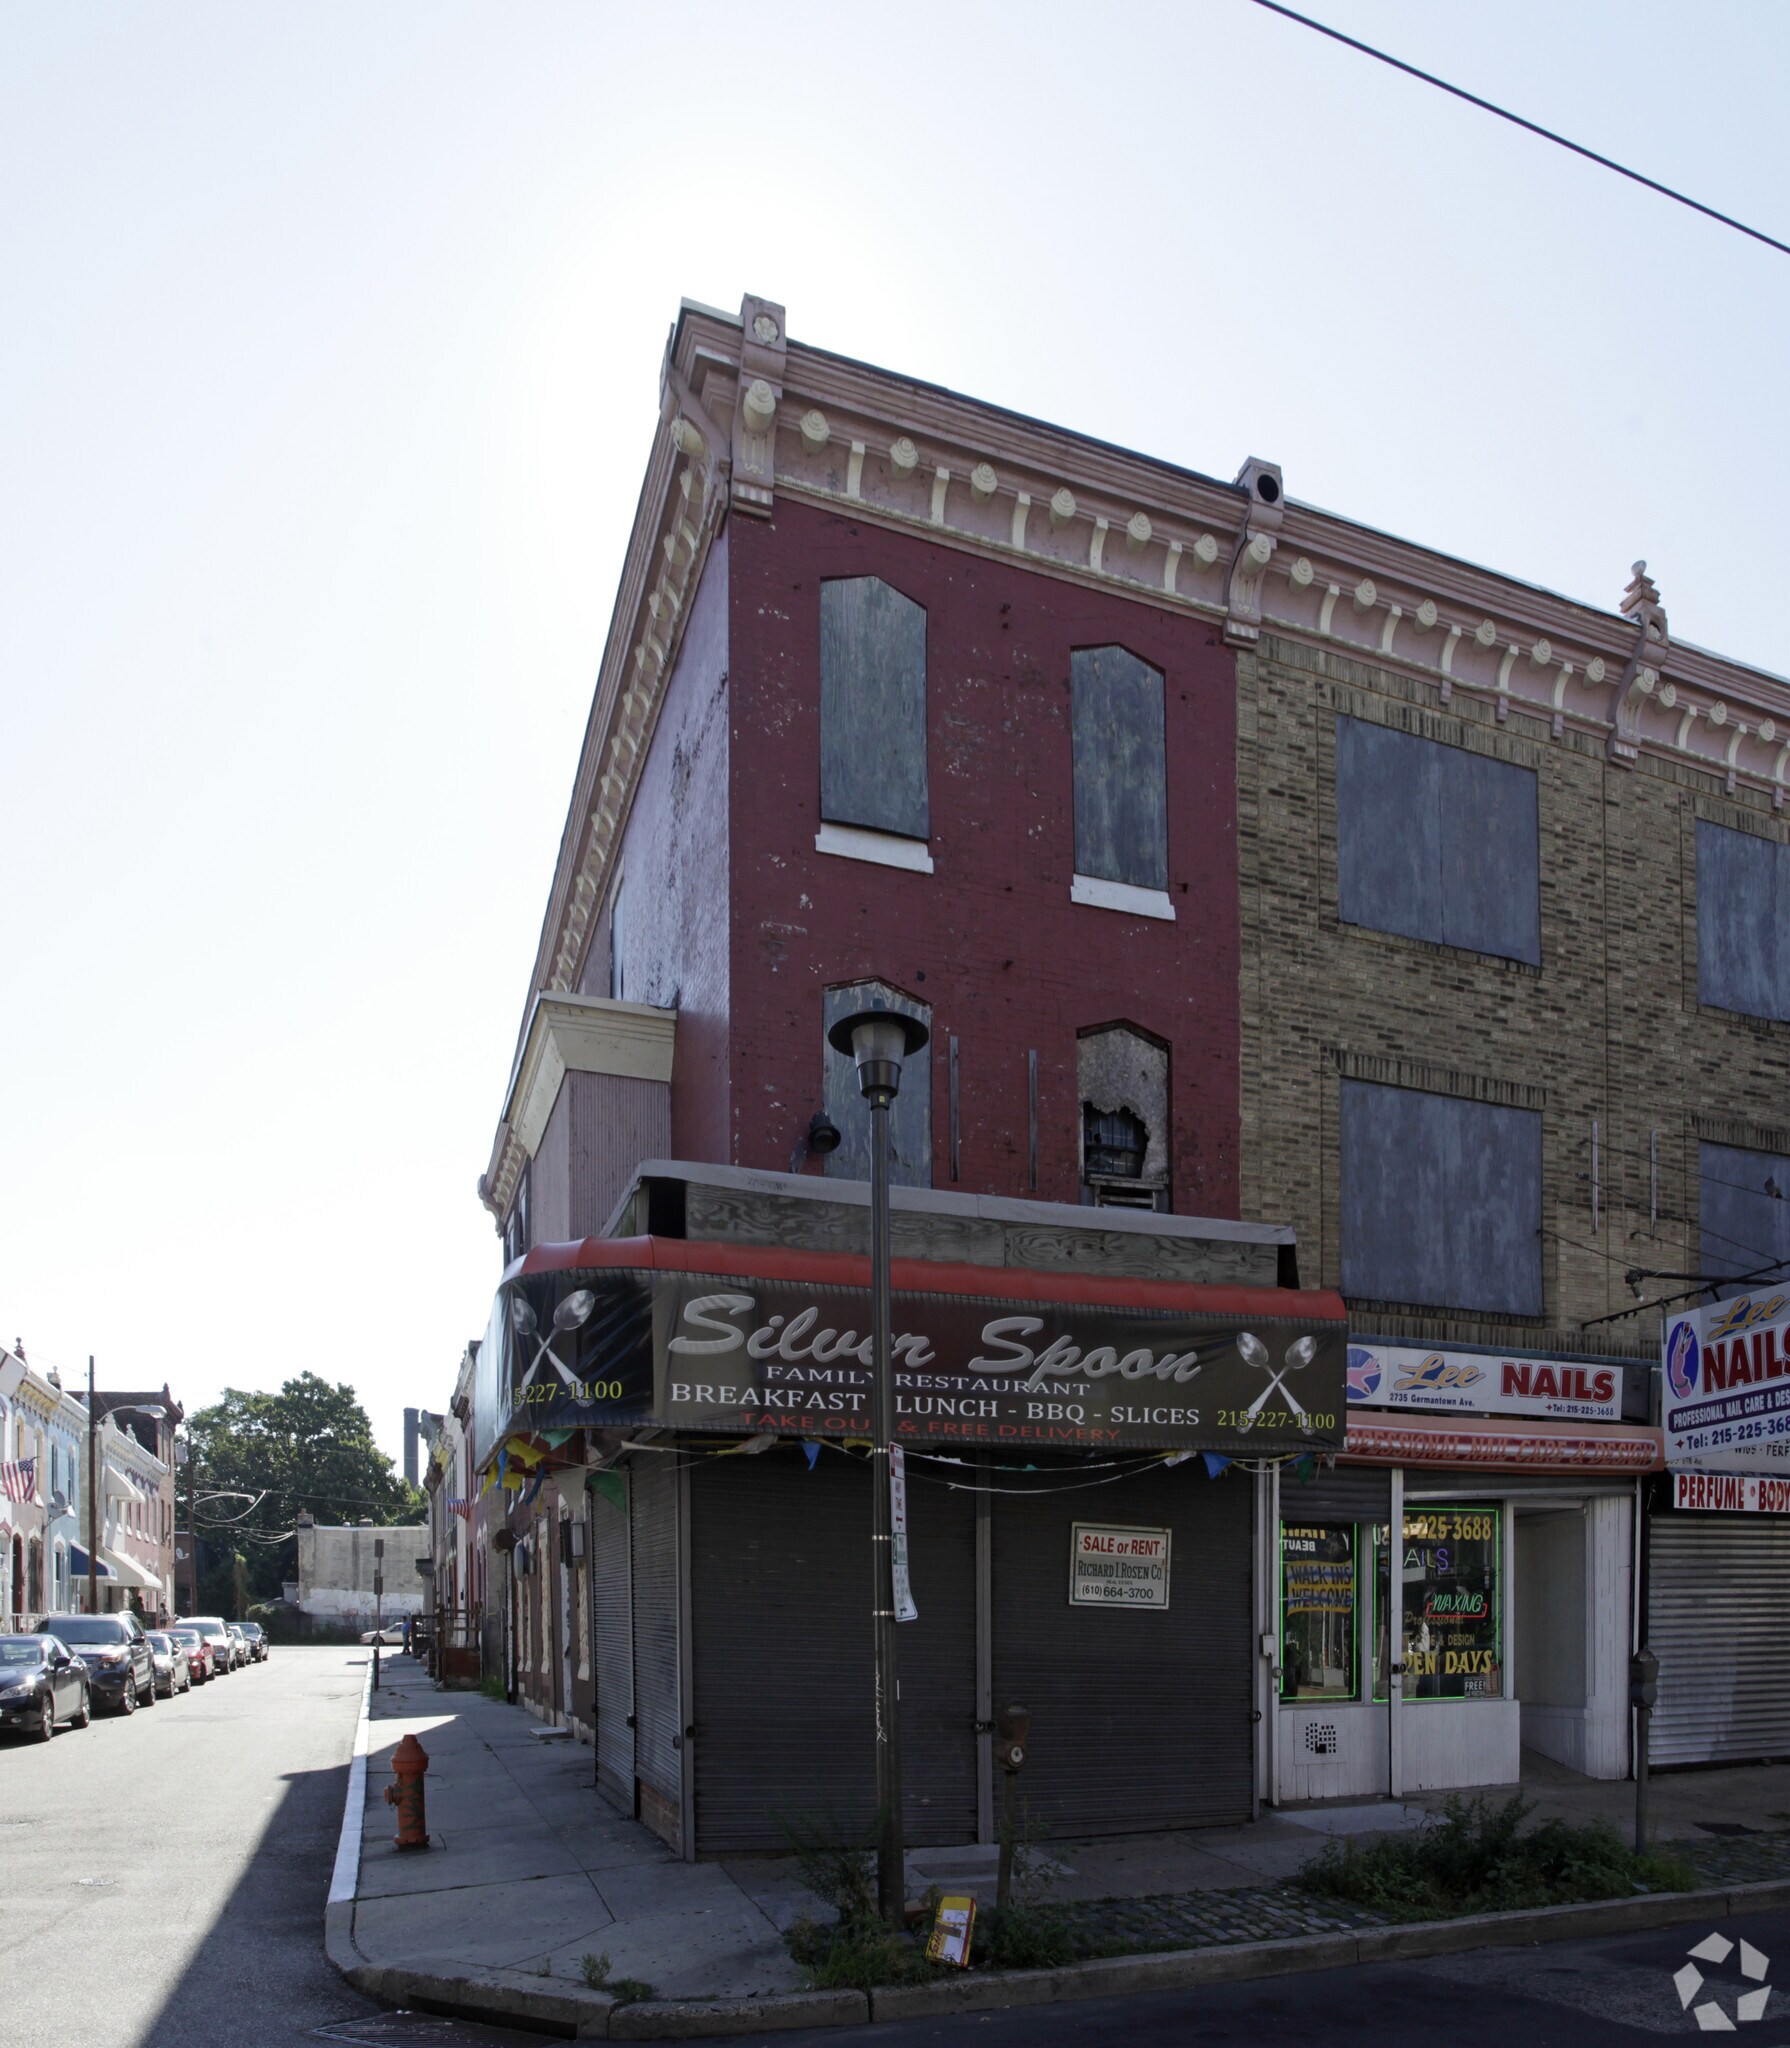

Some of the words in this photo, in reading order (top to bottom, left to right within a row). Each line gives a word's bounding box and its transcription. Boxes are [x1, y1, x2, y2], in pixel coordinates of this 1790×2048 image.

[1708, 1296, 1790, 1341] Lee
[667, 1294, 936, 1367] Silver
[967, 1316, 1202, 1394] Spoon
[1393, 1353, 1486, 1391] Lee
[1501, 1362, 1615, 1403] NAILS
[895, 1373, 1091, 1396] RESTAURANT
[896, 1396, 998, 1418] LUNCH
[1026, 1402, 1086, 1424] BBQ
[1110, 1406, 1200, 1426] SLICES
[1389, 1393, 1408, 1403] 2735
[1410, 1394, 1458, 1407] Germantown
[1458, 1398, 1475, 1408] Ave.
[1553, 1403, 1566, 1413] Tel:
[1566, 1404, 1614, 1416] 215-225-3688
[1672, 1405, 1725, 1430] PROFESSIONAL
[1726, 1400, 1743, 1418] NAIL
[1744, 1395, 1765, 1414] CARE
[1766, 1393, 1773, 1408] &
[741, 1412, 815, 1428] TAKE
[824, 1416, 871, 1431] OU
[896, 1420, 919, 1433] &
[928, 1421, 994, 1436] FREE
[1000, 1424, 1121, 1441] DELIVERY
[1217, 1410, 1336, 1431] 215-227-1100
[1516, 1440, 1567, 1463] CARE
[1588, 1442, 1653, 1465] DESIGN
[1687, 1433, 1709, 1451] Tel:
[1678, 1474, 1745, 1510] PERFUME
[1083, 1535, 1115, 1553] SALE
[1117, 1542, 1129, 1554] or
[1131, 1539, 1160, 1556] RENT
[1291, 1566, 1328, 1585] WALK
[1103, 1586, 1154, 1599] 664-3700
[1292, 1588, 1351, 1608] WELCOME
[1432, 1593, 1483, 1613] WAXING
[1447, 1633, 1475, 1646] DESIGN
[1444, 1649, 1493, 1675] DAYS
